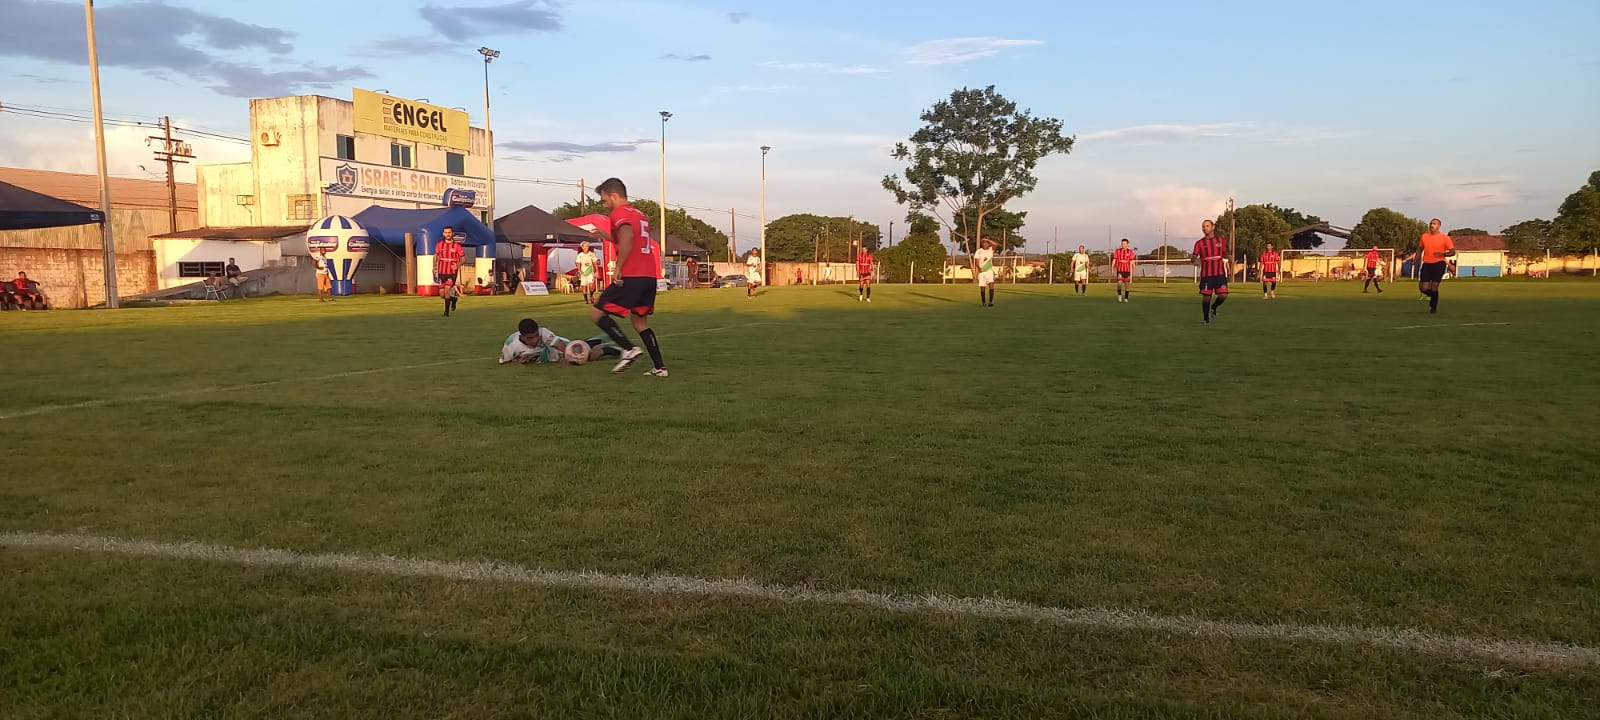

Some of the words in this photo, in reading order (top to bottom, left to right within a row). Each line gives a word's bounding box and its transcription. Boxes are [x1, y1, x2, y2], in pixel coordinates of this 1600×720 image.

[383, 124, 408, 135] MATERIAIS
[408, 129, 419, 137] PARA
[393, 103, 447, 132] ENGEL
[361, 167, 407, 189] ISRAEL
[410, 172, 448, 193] SOLAR
[361, 185, 378, 196] Energia
[379, 187, 390, 195] solar
[640, 219, 651, 254] 5
